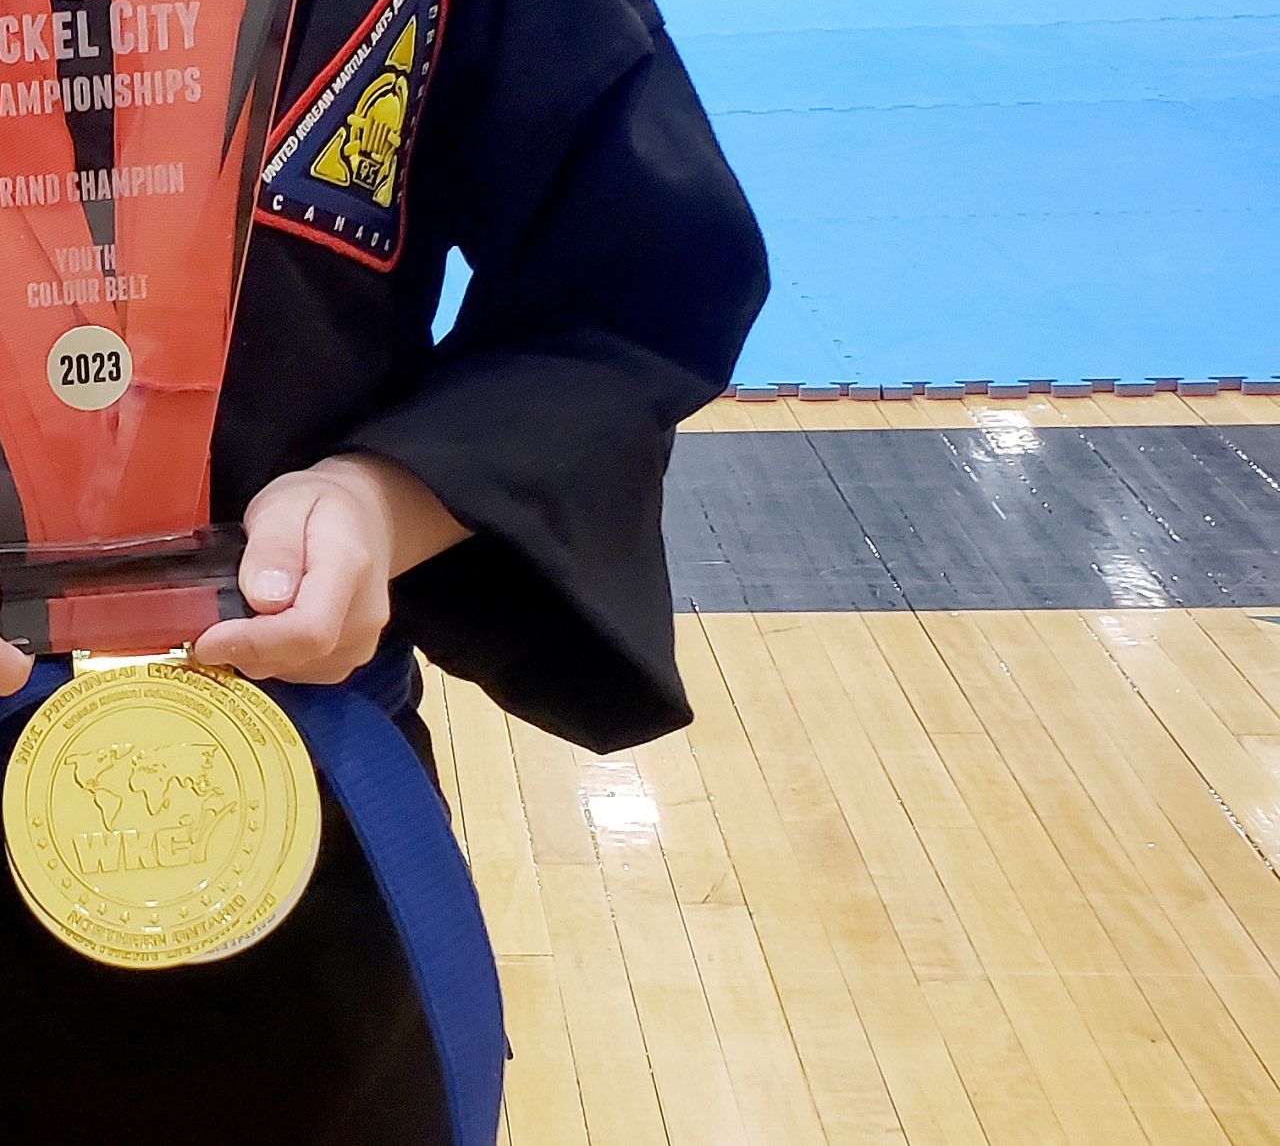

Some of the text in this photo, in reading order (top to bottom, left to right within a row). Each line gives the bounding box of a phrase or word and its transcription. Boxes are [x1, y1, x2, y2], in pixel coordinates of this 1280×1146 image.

[109, 0, 201, 56] CITY
[261, 136, 299, 185] UNITED
[297, 89, 335, 141] KOREAN
[332, 42, 373, 97] MARTIAL
[370, 9, 393, 48] ARTS
[65, 162, 186, 203] CHAMPION
[55, 243, 116, 274] YOUTH
[26, 274, 149, 309] COLOUR BELT
[60, 351, 122, 386] 2023
[67, 909, 168, 948] NORTHERN
[174, 893, 248, 944] ONTARIO
